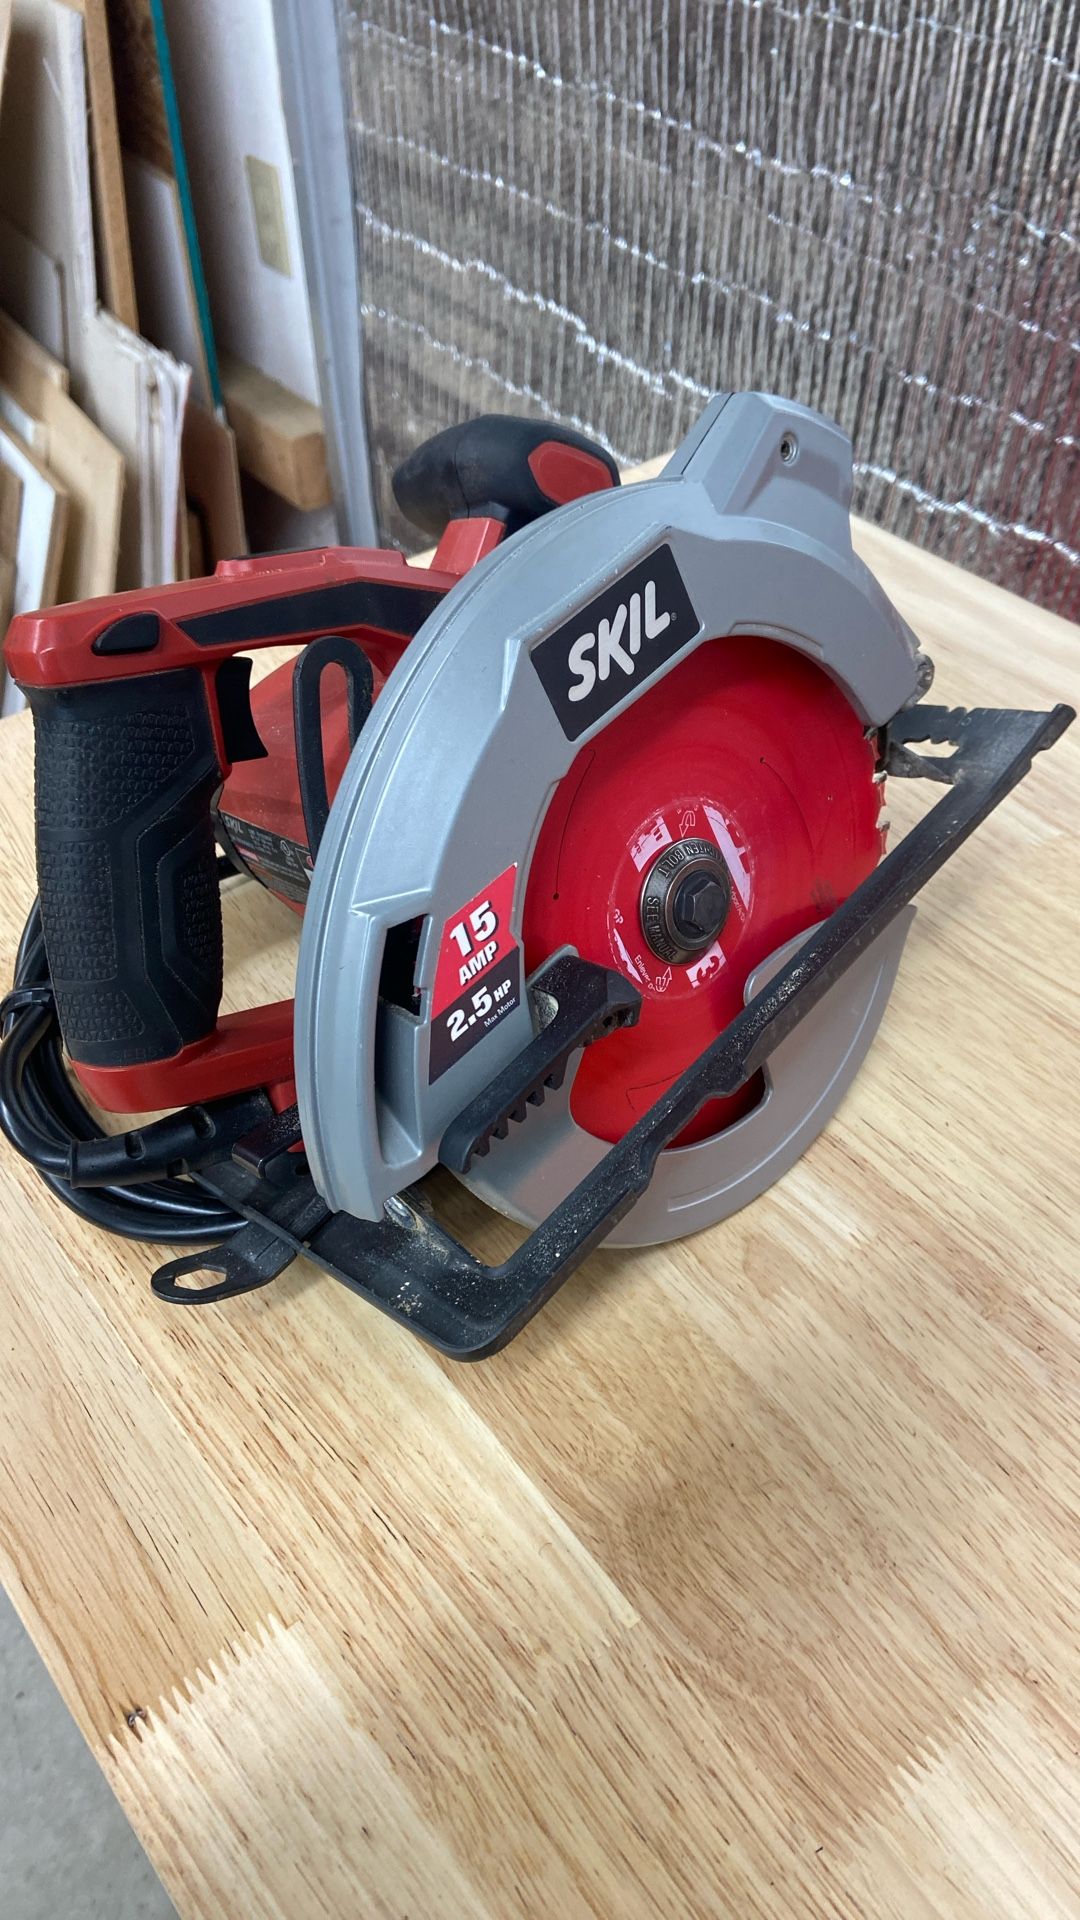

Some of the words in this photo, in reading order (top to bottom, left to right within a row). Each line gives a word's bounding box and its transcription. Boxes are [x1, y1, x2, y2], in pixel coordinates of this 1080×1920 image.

[567, 580, 671, 702] SKIL
[657, 847, 685, 878] BOLT
[449, 900, 498, 957] 15
[646, 896, 660, 922] SEE
[648, 925, 678, 960] MANUAL
[459, 941, 498, 986] AMP
[446, 986, 493, 1042] 2.5
[494, 979, 512, 1003] HP
[484, 1014, 498, 1028] Max
[497, 997, 516, 1017] Motor
